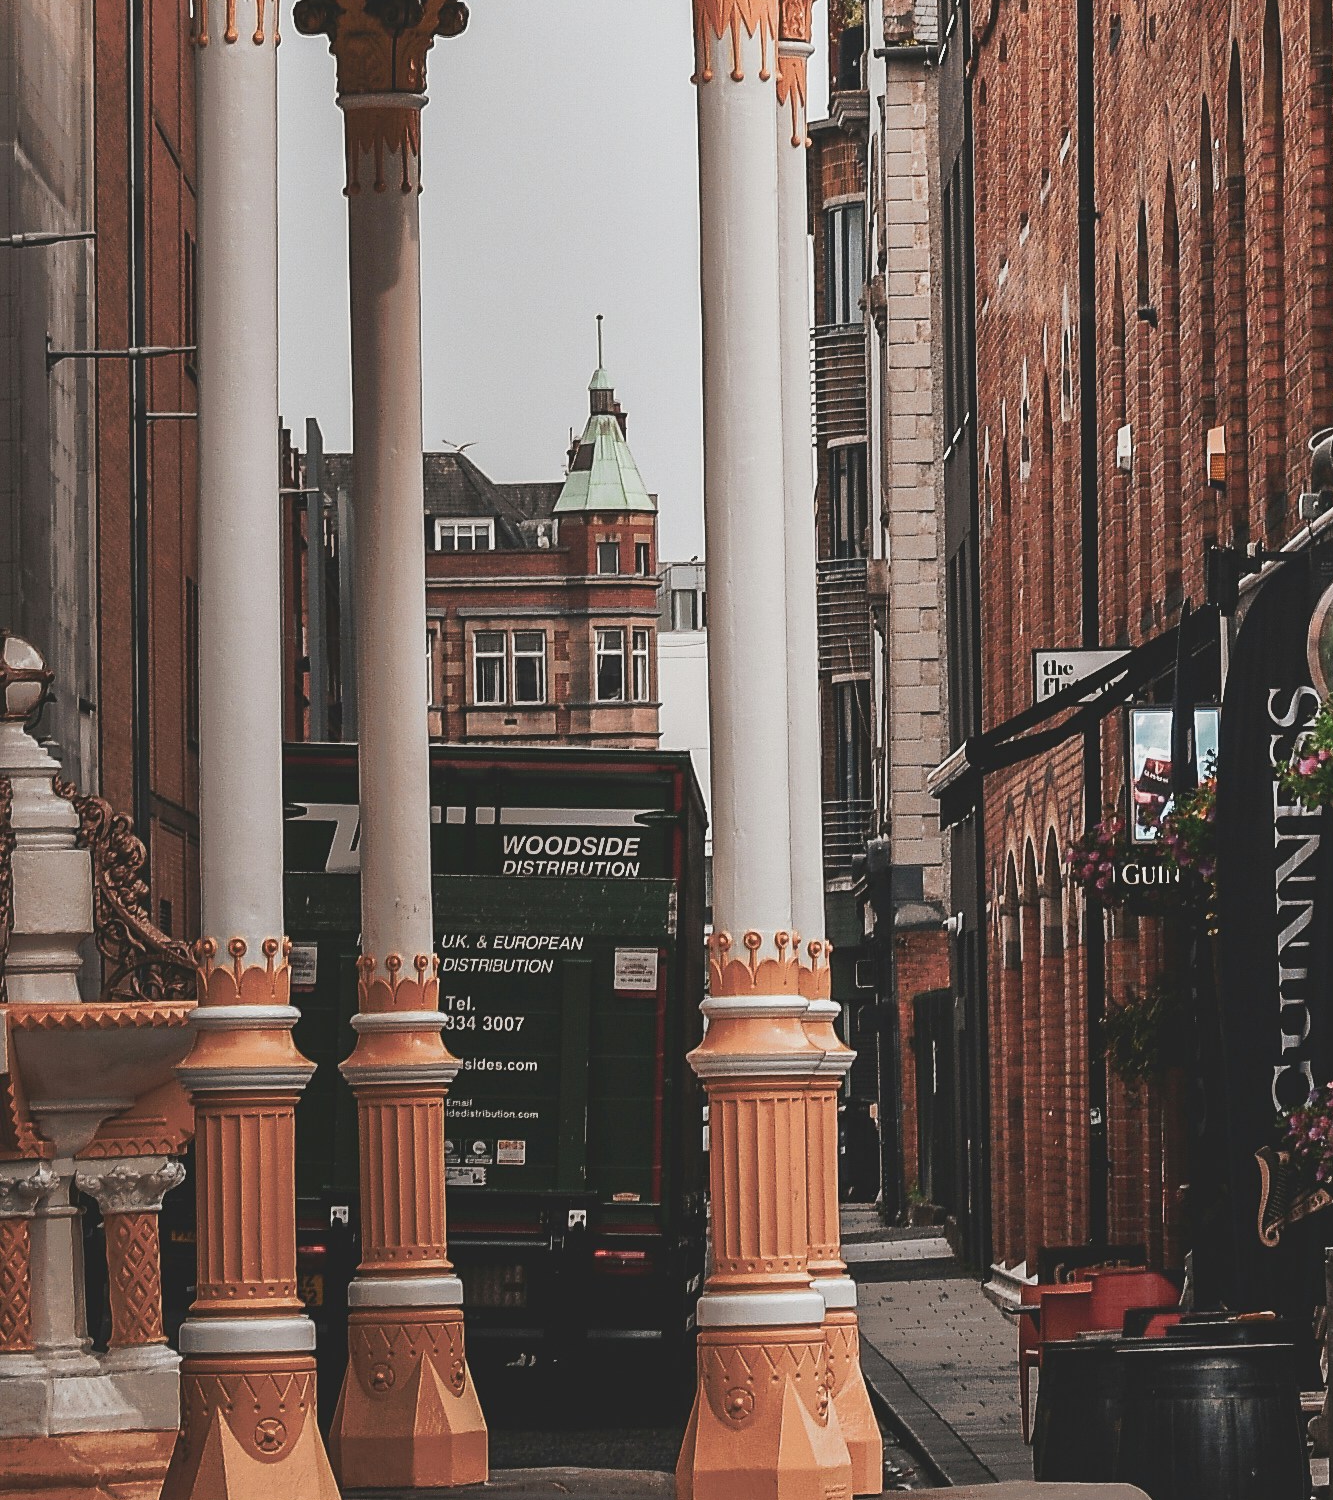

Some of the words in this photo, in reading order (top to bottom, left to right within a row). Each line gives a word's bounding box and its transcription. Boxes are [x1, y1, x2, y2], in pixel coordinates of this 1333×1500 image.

[1042, 659, 1074, 676] the
[503, 835, 641, 857] WOODSIDE
[502, 860, 640, 877] DISTRIBUTION
[1267, 685, 1323, 1116] GUINNESS
[441, 934, 470, 949] U.K.
[476, 935, 487, 949] &
[493, 935, 584, 950] EUROPEAN
[442, 958, 554, 974] DISTRIBUTION
[445, 995, 476, 1011] Tel.
[482, 1016, 525, 1031] 3007
[460, 1058, 538, 1072] sides.com
[446, 1099, 473, 1107] Email
[445, 1109, 539, 1119] idedistribution.com
